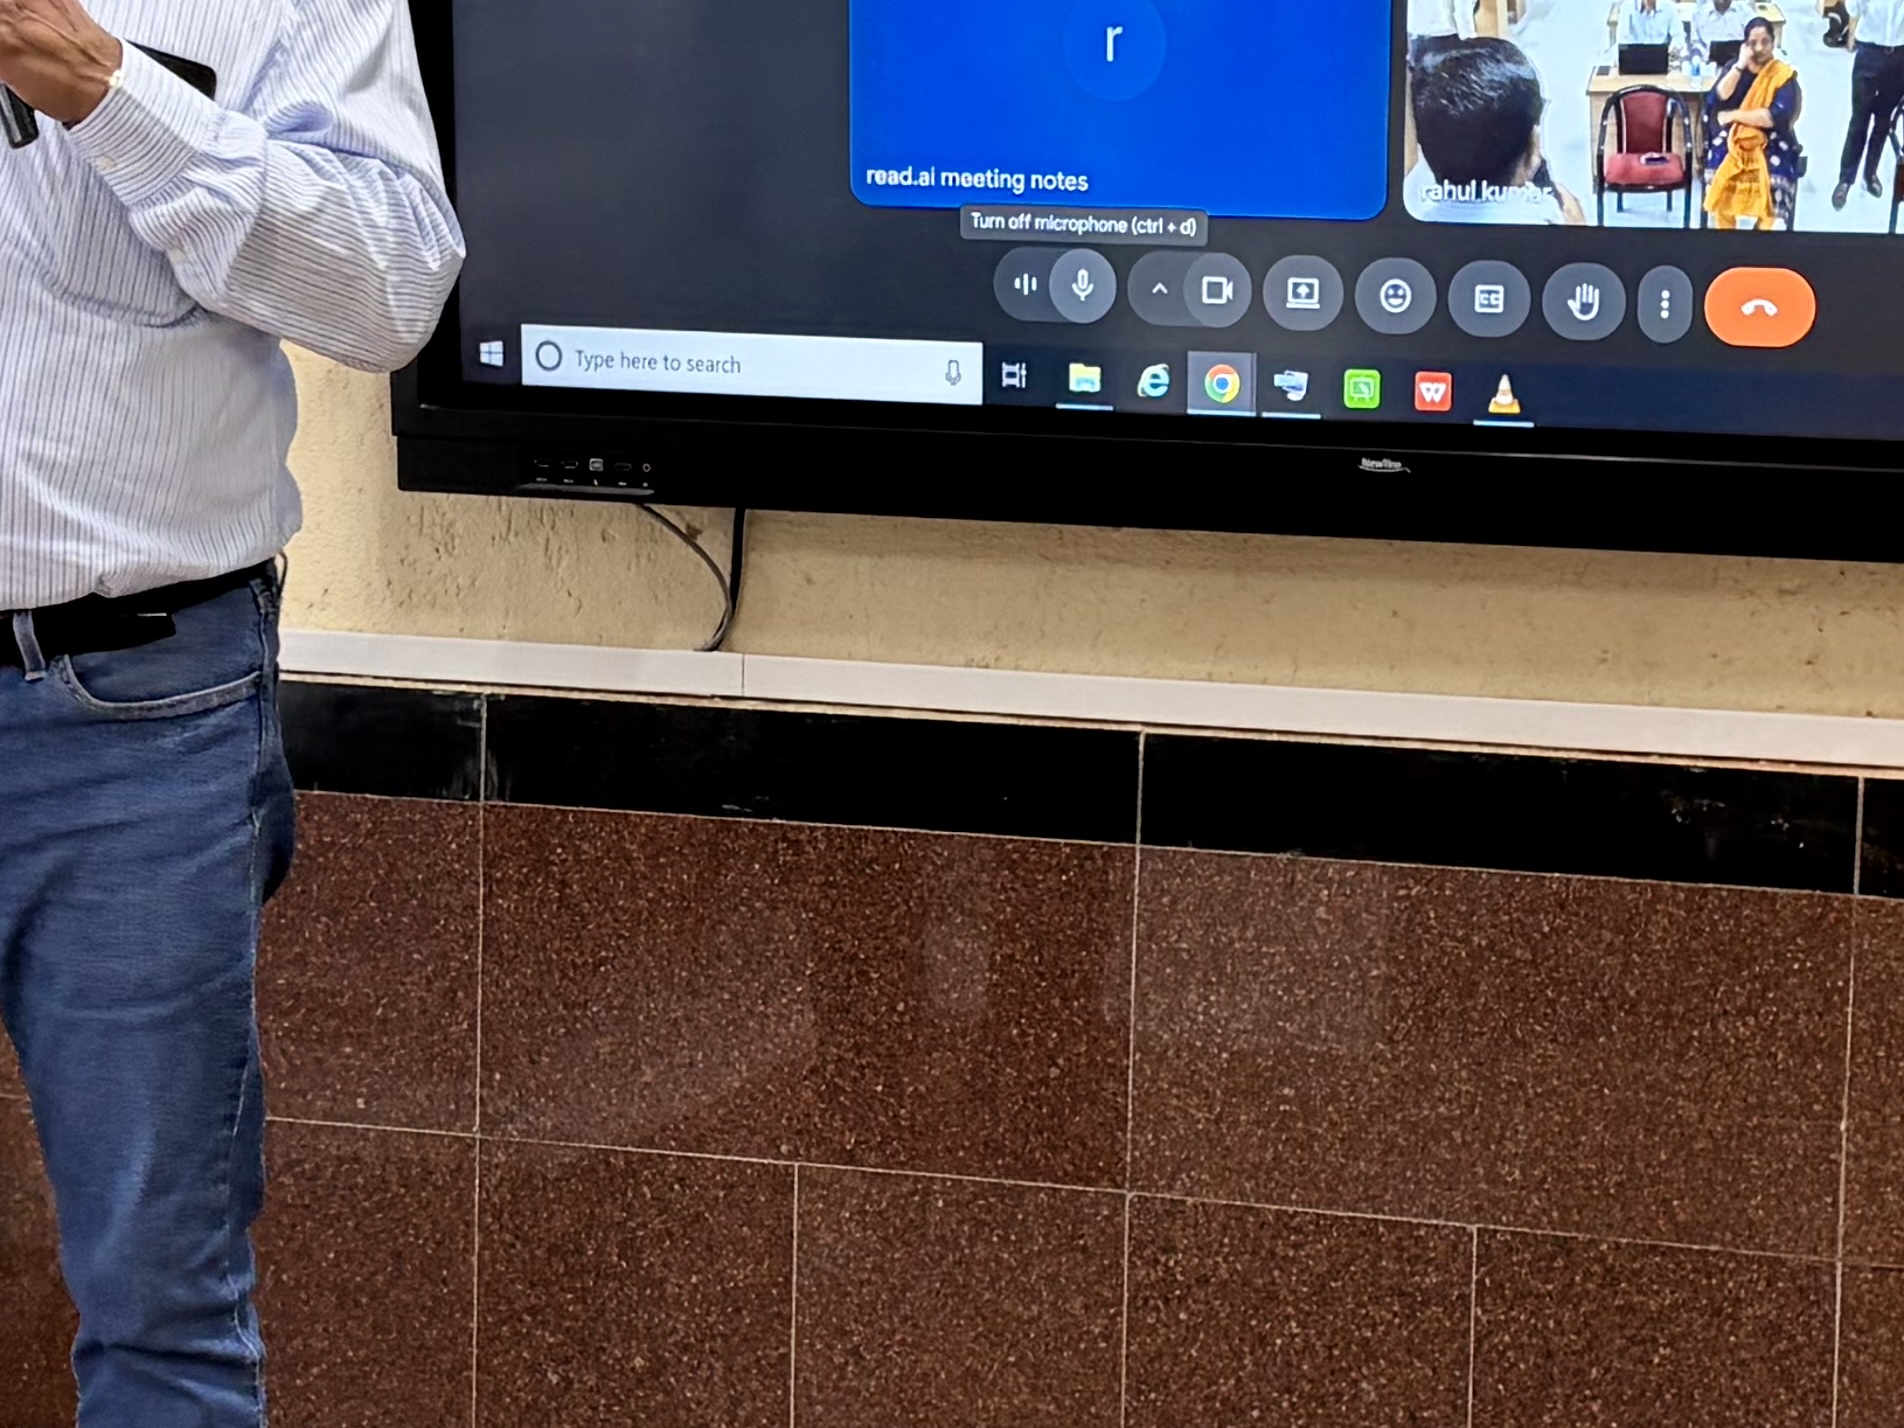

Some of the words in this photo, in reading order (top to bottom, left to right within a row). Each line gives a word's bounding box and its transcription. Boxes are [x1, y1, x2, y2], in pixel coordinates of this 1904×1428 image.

[1107, 26, 1123, 62] r
[866, 165, 935, 186] read.ai
[941, 167, 1026, 195] meeting
[1030, 171, 1089, 192] notes
[1422, 179, 1477, 202] rahul
[971, 212, 1005, 230] Turn
[1008, 213, 1032, 231] off
[1035, 215, 1128, 237] microphone
[1131, 219, 1164, 236] (ctrl
[1179, 221, 1197, 237] d)
[575, 349, 615, 372] Type
[620, 350, 657, 370] here
[663, 354, 681, 371] to
[686, 355, 741, 374] search
